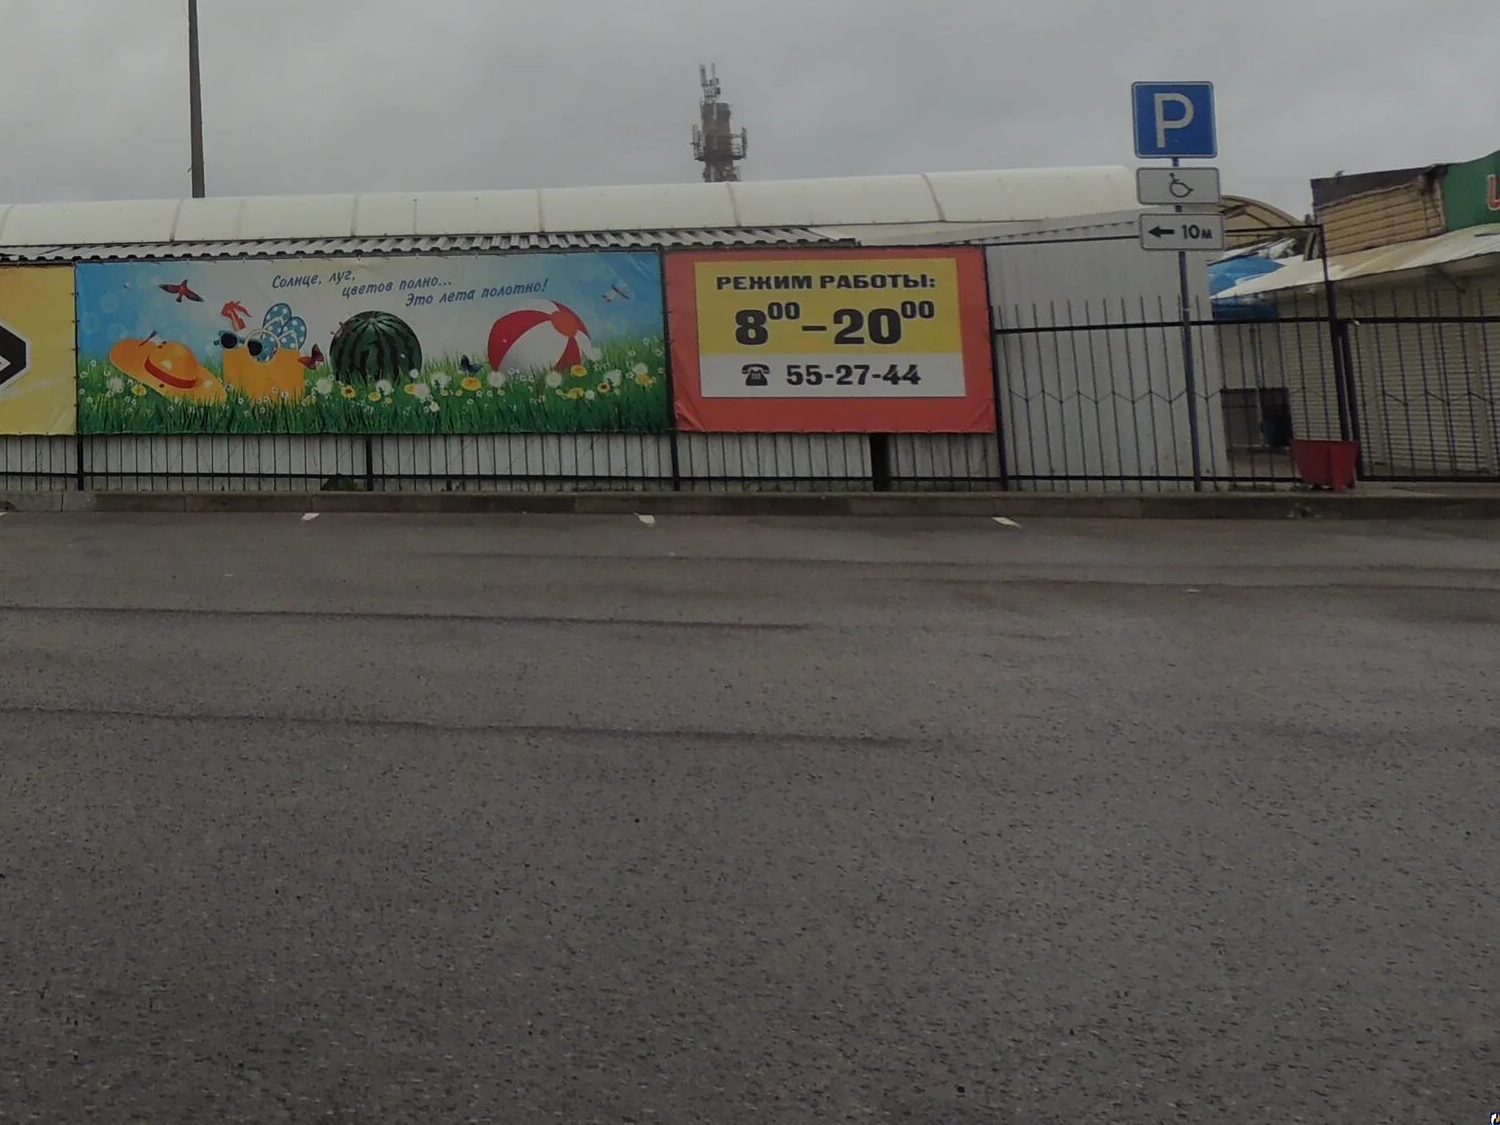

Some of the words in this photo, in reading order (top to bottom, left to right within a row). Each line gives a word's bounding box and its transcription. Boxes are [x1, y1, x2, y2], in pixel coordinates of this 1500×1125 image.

[1154, 92, 1195, 149] P
[271, 274, 322, 290] Солнце,
[328, 269, 356, 286] луг,
[341, 279, 394, 299] цветов
[398, 276, 452, 291] полно...
[716, 275, 813, 291] РЕЖИМ
[819, 273, 937, 289] РАБОТЫ:
[404, 292, 434, 307] Это
[438, 288, 476, 304] лета
[481, 277, 550, 299] полотно!
[786, 364, 922, 387] 55-27-44
